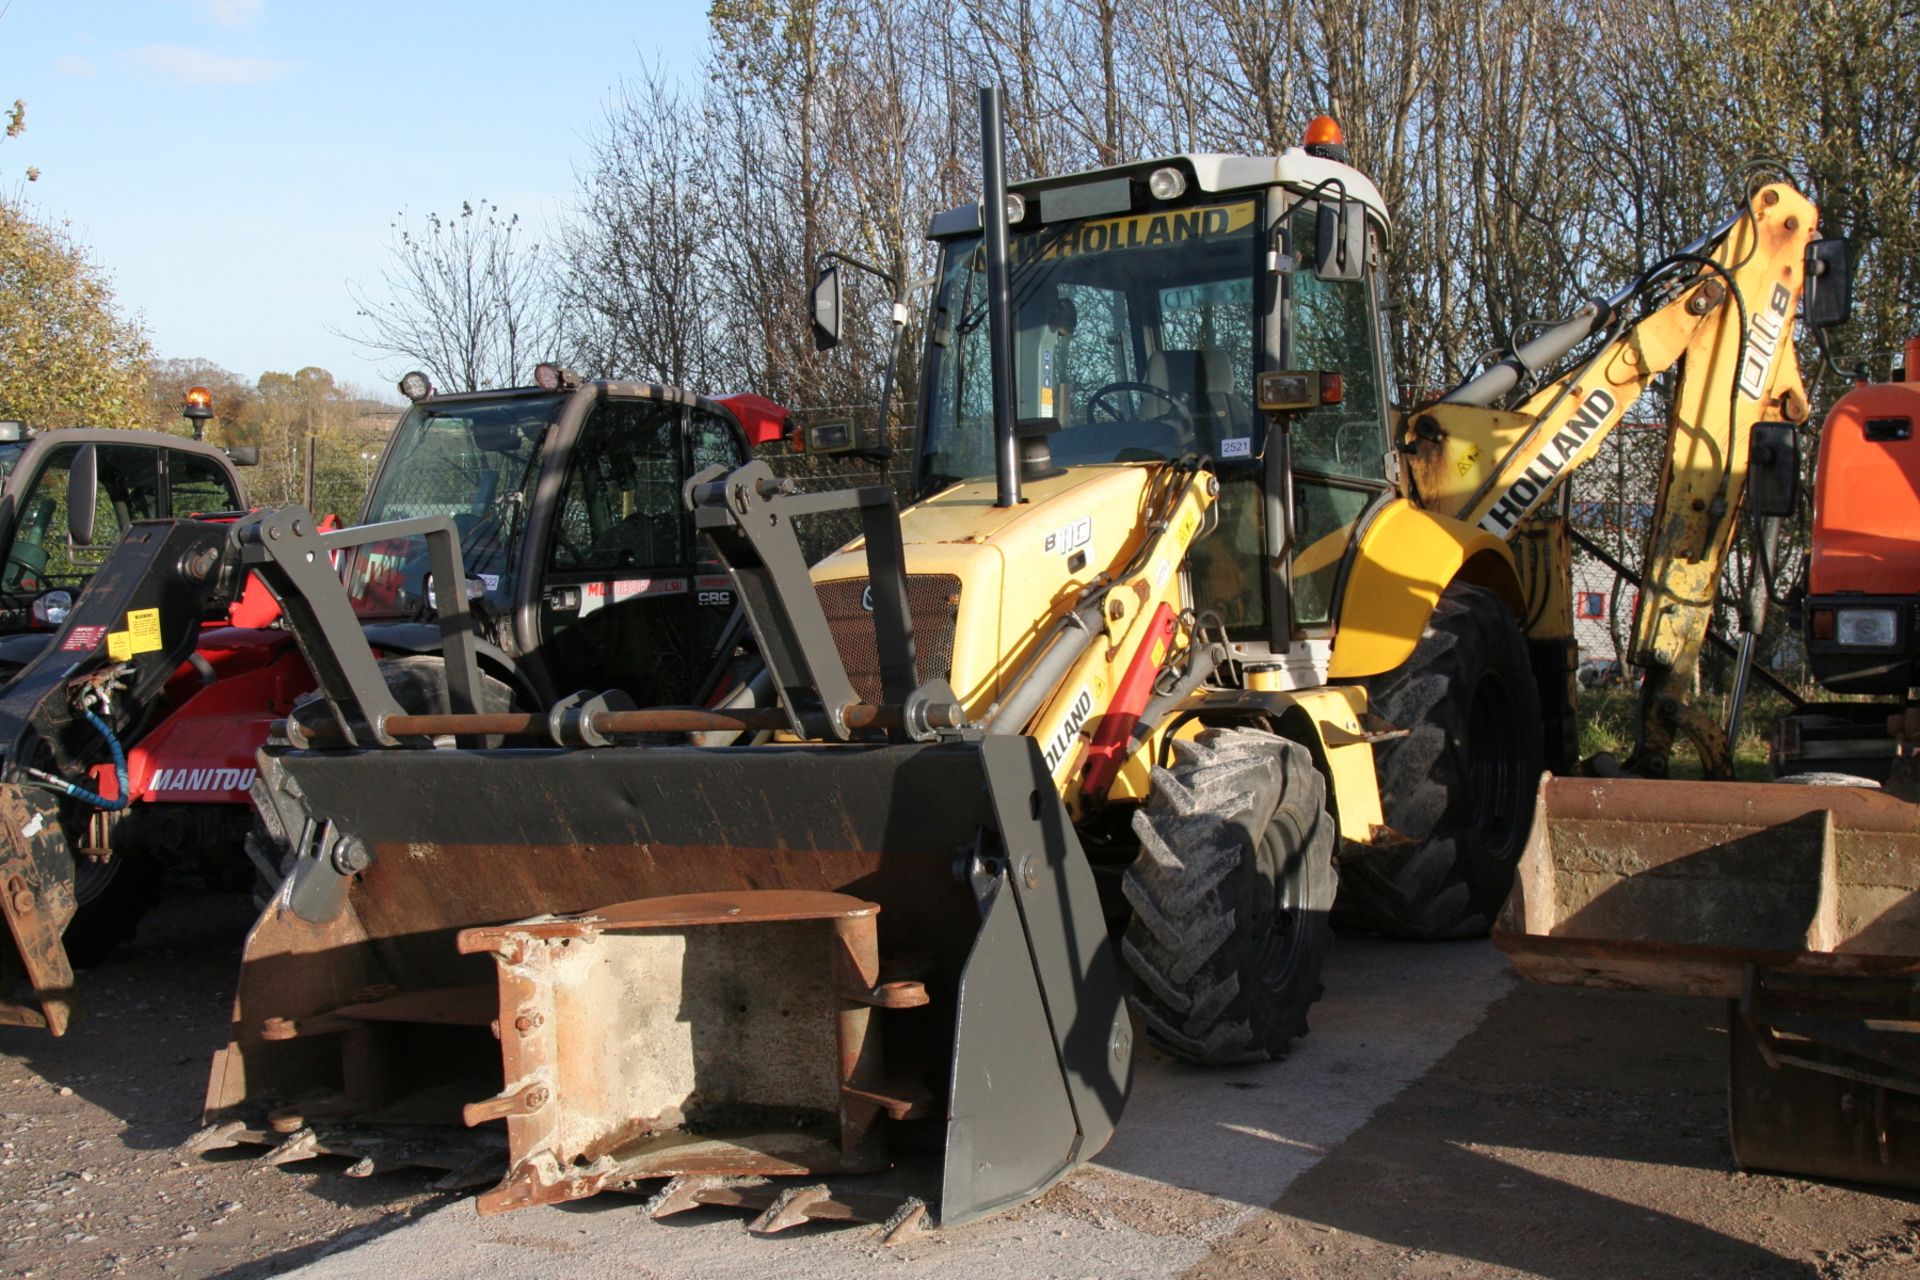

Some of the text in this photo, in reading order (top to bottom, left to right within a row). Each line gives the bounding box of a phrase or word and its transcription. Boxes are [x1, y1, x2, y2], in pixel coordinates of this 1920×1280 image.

[1056, 208, 1230, 258] HOLLAND
[1740, 281, 1791, 401] B110
[1223, 442, 1248, 453] 2521
[1488, 389, 1615, 530] HOLLAND
[1045, 514, 1092, 555] B110
[698, 592, 730, 602] CRC
[148, 768, 257, 791] MANITOU
